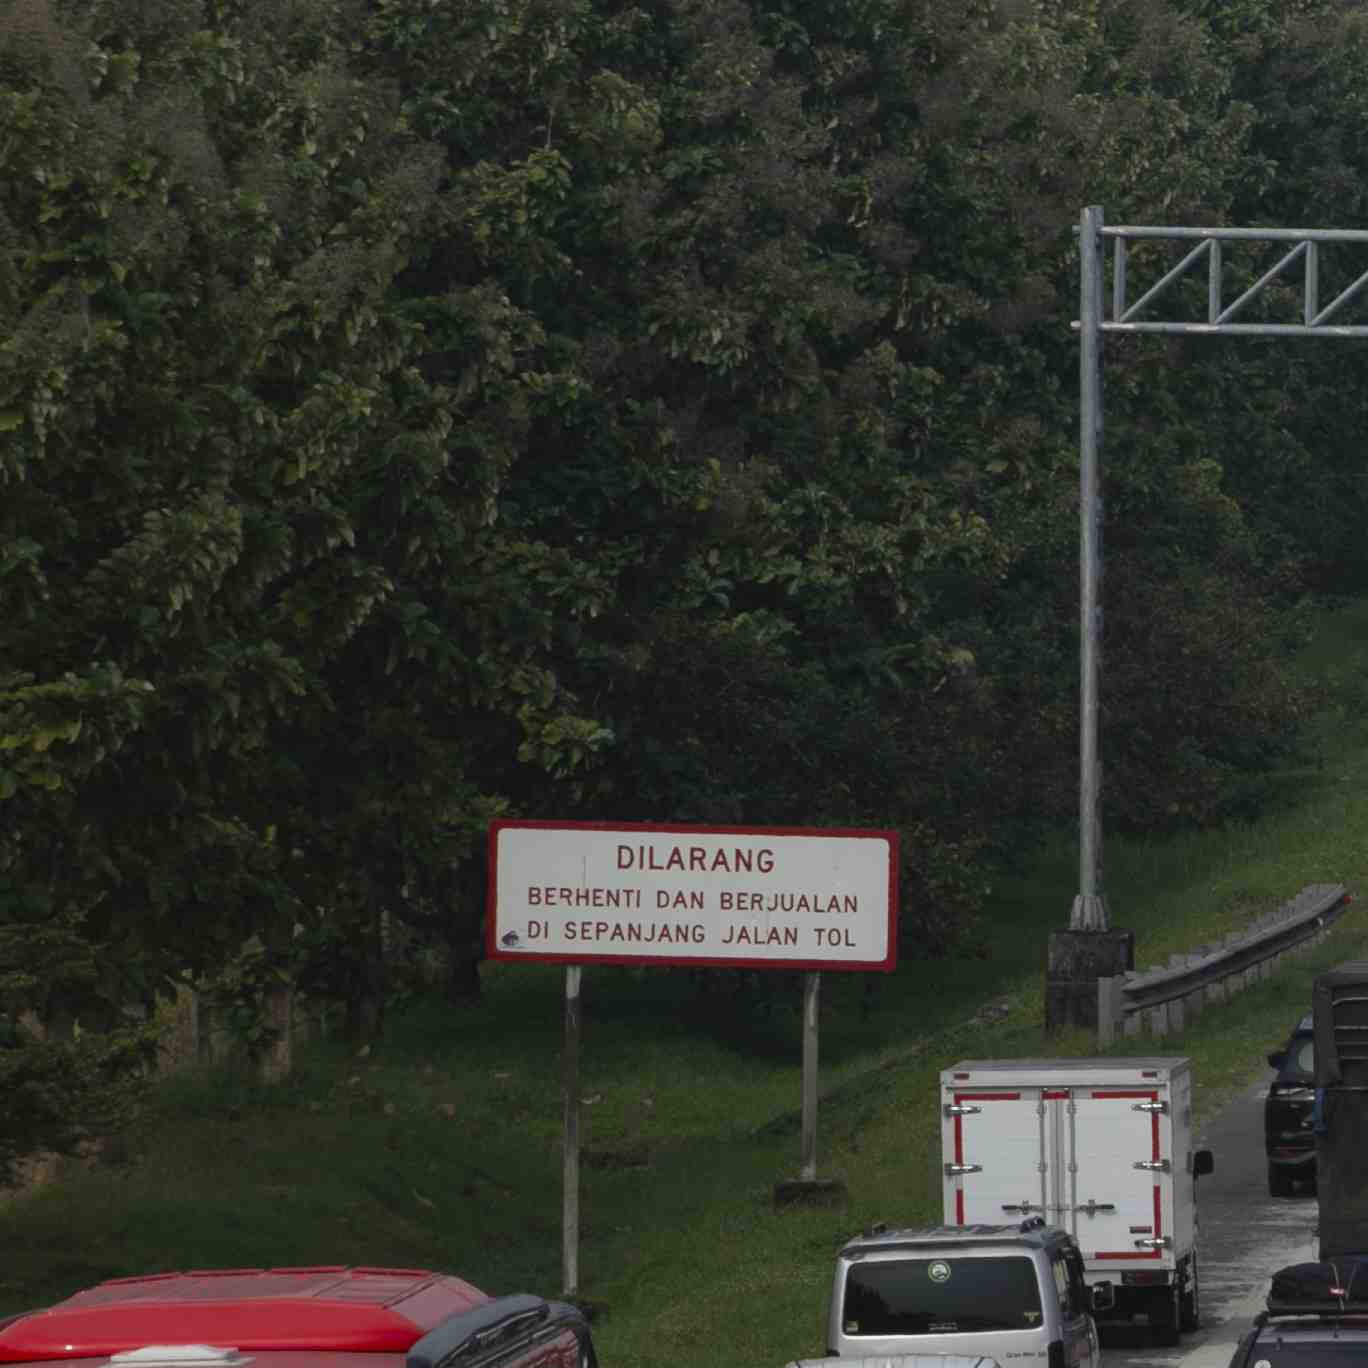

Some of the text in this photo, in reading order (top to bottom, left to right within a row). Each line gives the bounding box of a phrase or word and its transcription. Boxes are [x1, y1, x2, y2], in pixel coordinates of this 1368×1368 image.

[616, 845, 775, 873] DILARANG
[528, 887, 858, 913] BERHENTI DAN BERJUALAN
[527, 920, 857, 947] DI SEPANJANG JALAN TOL
